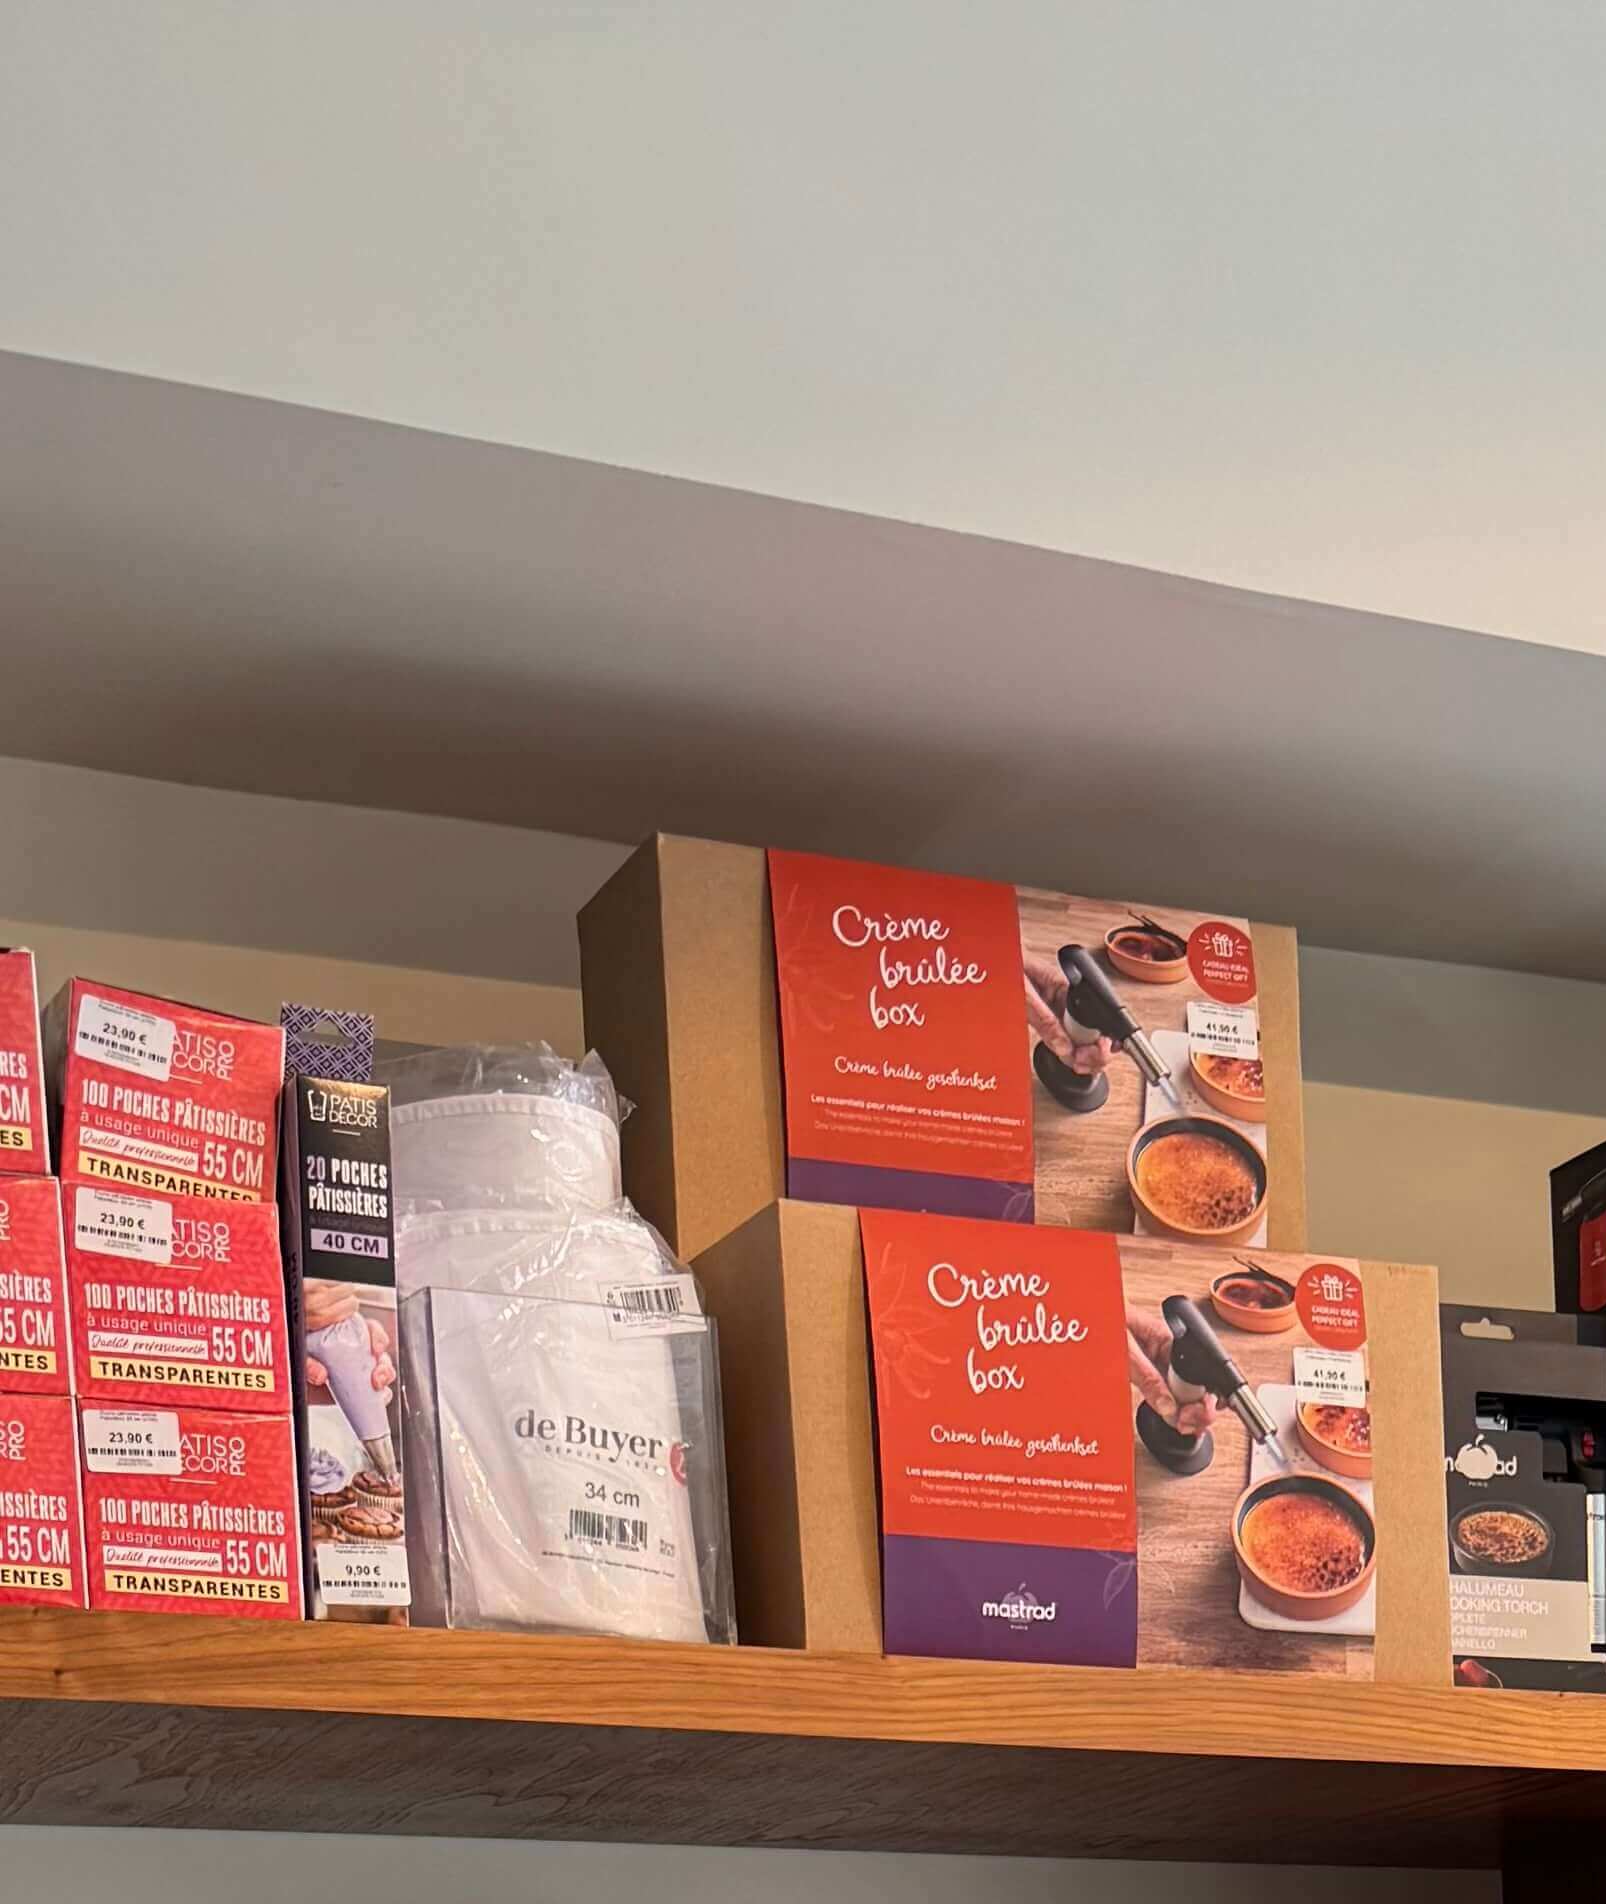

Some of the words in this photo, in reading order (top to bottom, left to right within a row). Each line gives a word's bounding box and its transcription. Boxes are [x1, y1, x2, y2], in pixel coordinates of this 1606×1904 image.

[833, 905, 949, 948] Crème
[880, 947, 987, 986] brûlée
[869, 992, 925, 1029] box
[82, 1079, 105, 1106] 100
[113, 1086, 169, 1124] POCHES
[175, 1096, 266, 1147] PÂTISSIÈRES
[329, 1111, 378, 1128] DECOR
[330, 1094, 377, 1116] PATIS
[96, 1114, 142, 1136] usage
[150, 1125, 199, 1149] unique
[203, 1142, 226, 1178] 55
[232, 1150, 263, 1188] CM
[307, 1156, 325, 1180] 20
[331, 1158, 388, 1190] POCHES
[308, 1182, 388, 1218] PÂTISSIÈRES
[100, 1212, 134, 1228] 23,90
[323, 1232, 345, 1250] 40
[351, 1236, 380, 1254] CM
[84, 1282, 111, 1310] 100
[117, 1286, 173, 1316] POCHES
[179, 1286, 270, 1324] PÂTISSIÈRES
[928, 1264, 1050, 1308] Crème
[22, 1309, 55, 1347] CM
[101, 1316, 148, 1334] usage
[154, 1320, 206, 1336] unique
[977, 1305, 1088, 1351] brûlée
[212, 1327, 235, 1363] 55
[241, 1329, 273, 1366] CM
[99, 1361, 267, 1388] TRANSPARENTES
[968, 1350, 1025, 1394] box
[109, 1432, 142, 1444] 23,90
[515, 1408, 556, 1441] de
[564, 1415, 663, 1465] Buyer
[931, 1425, 976, 1443] Crème
[584, 1481, 606, 1501] 34
[614, 1490, 640, 1507] cm
[100, 1497, 126, 1525] 100
[132, 1500, 188, 1529] POCHES
[193, 1500, 285, 1536] PÂTISSIÈRES
[7, 1525, 31, 1561] 55
[37, 1528, 70, 1564] CM
[116, 1530, 162, 1547] usage
[168, 1534, 220, 1548] unique
[227, 1540, 250, 1574] 55
[255, 1542, 287, 1577] CM
[113, 1574, 281, 1600] TRANSPARENTES
[1450, 1580, 1524, 1597] HALUMEAU
[982, 1599, 1056, 1621] mastrad
[1451, 1597, 1500, 1612] OOKING
[1504, 1600, 1549, 1615] TORCH
